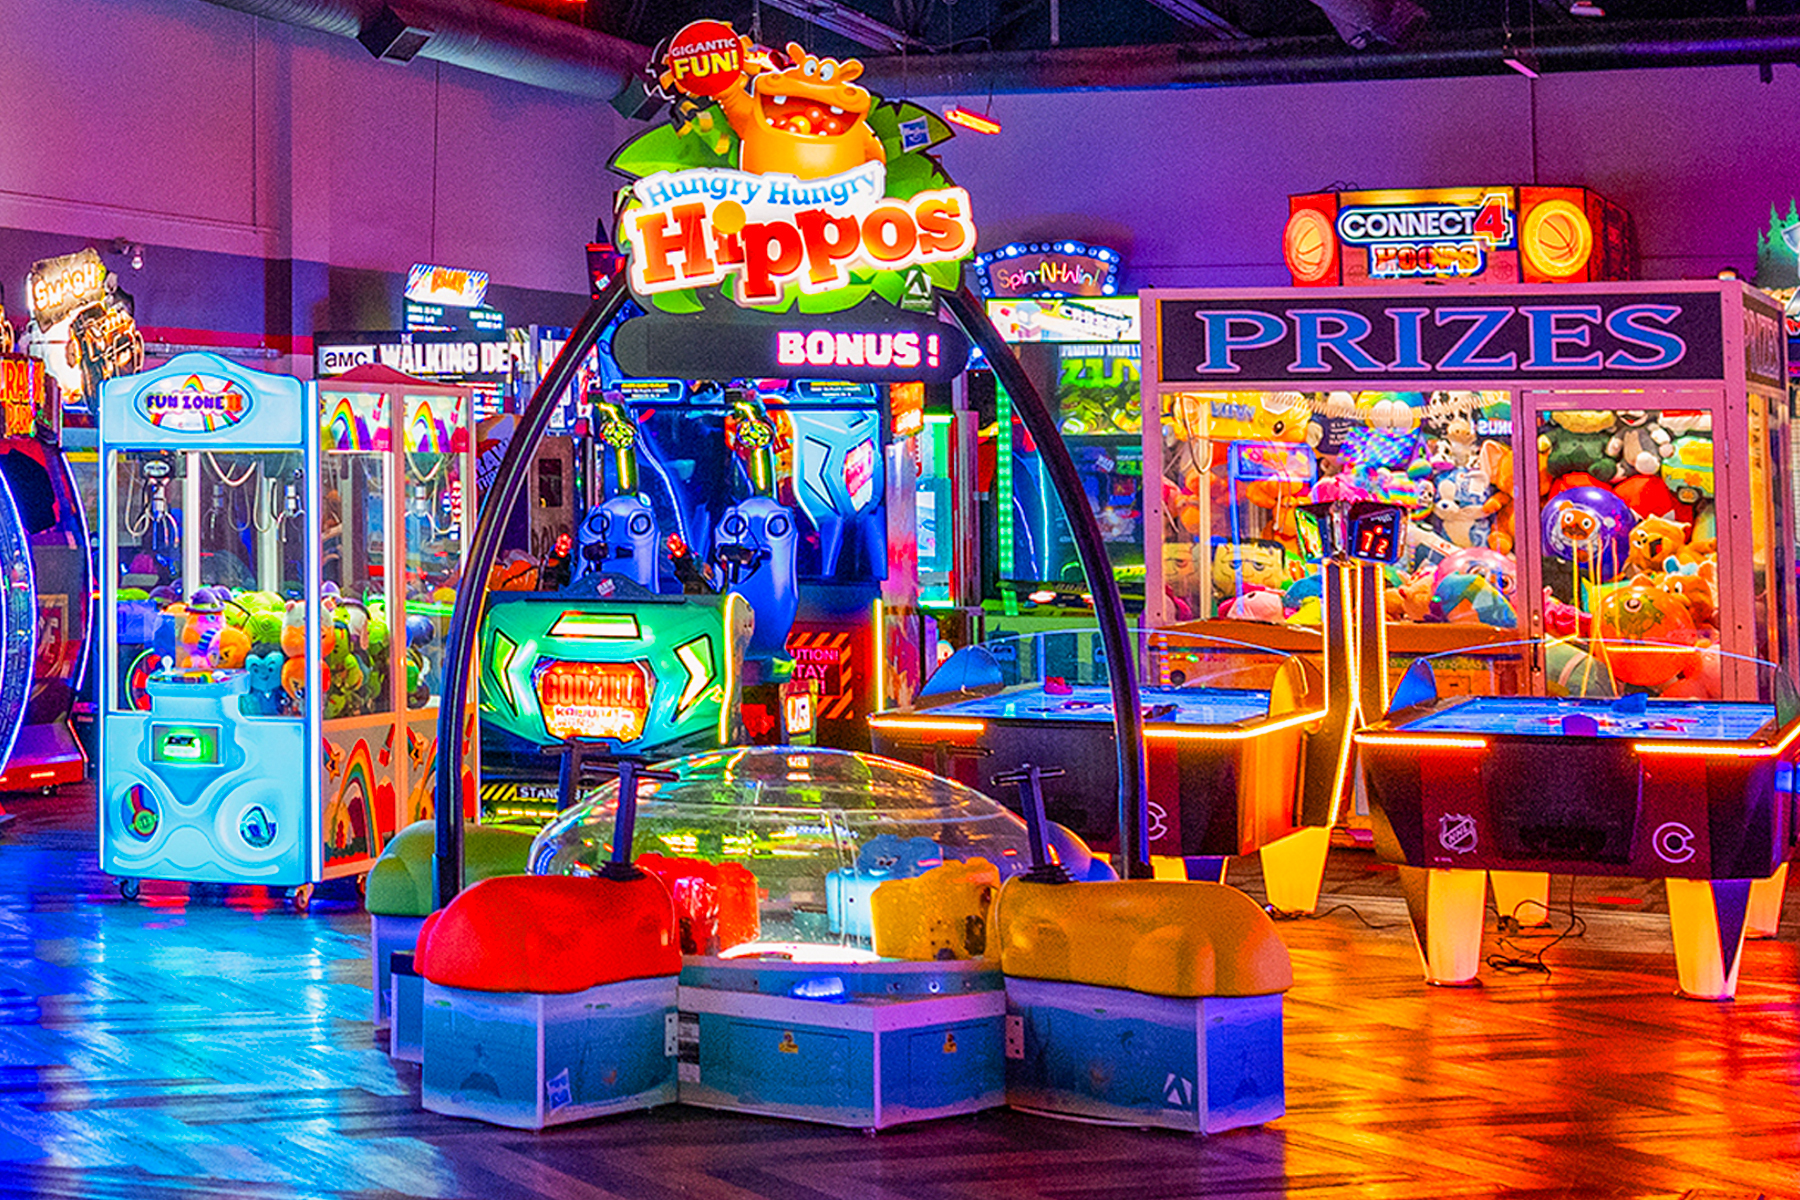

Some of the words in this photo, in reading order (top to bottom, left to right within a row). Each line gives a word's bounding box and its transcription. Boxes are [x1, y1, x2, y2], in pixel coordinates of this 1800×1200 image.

[672, 38, 737, 57] GIGANTIC
[674, 50, 739, 79] FUN!
[646, 176, 762, 207] Hungry
[767, 170, 877, 206] Hungry
[1343, 211, 1476, 238] CONNECT
[1473, 198, 1507, 240] 4
[635, 197, 965, 299] Hippos
[33, 261, 98, 311] SMASH
[777, 331, 920, 367] BONUS
[1195, 303, 1688, 374] PRIZES
[379, 343, 479, 375] WALKING
[147, 395, 178, 408] FUN
[182, 395, 224, 409] ZONE
[790, 649, 839, 660] UTION!
[791, 664, 828, 678] TAY
[546, 674, 646, 707] GODZILLA
